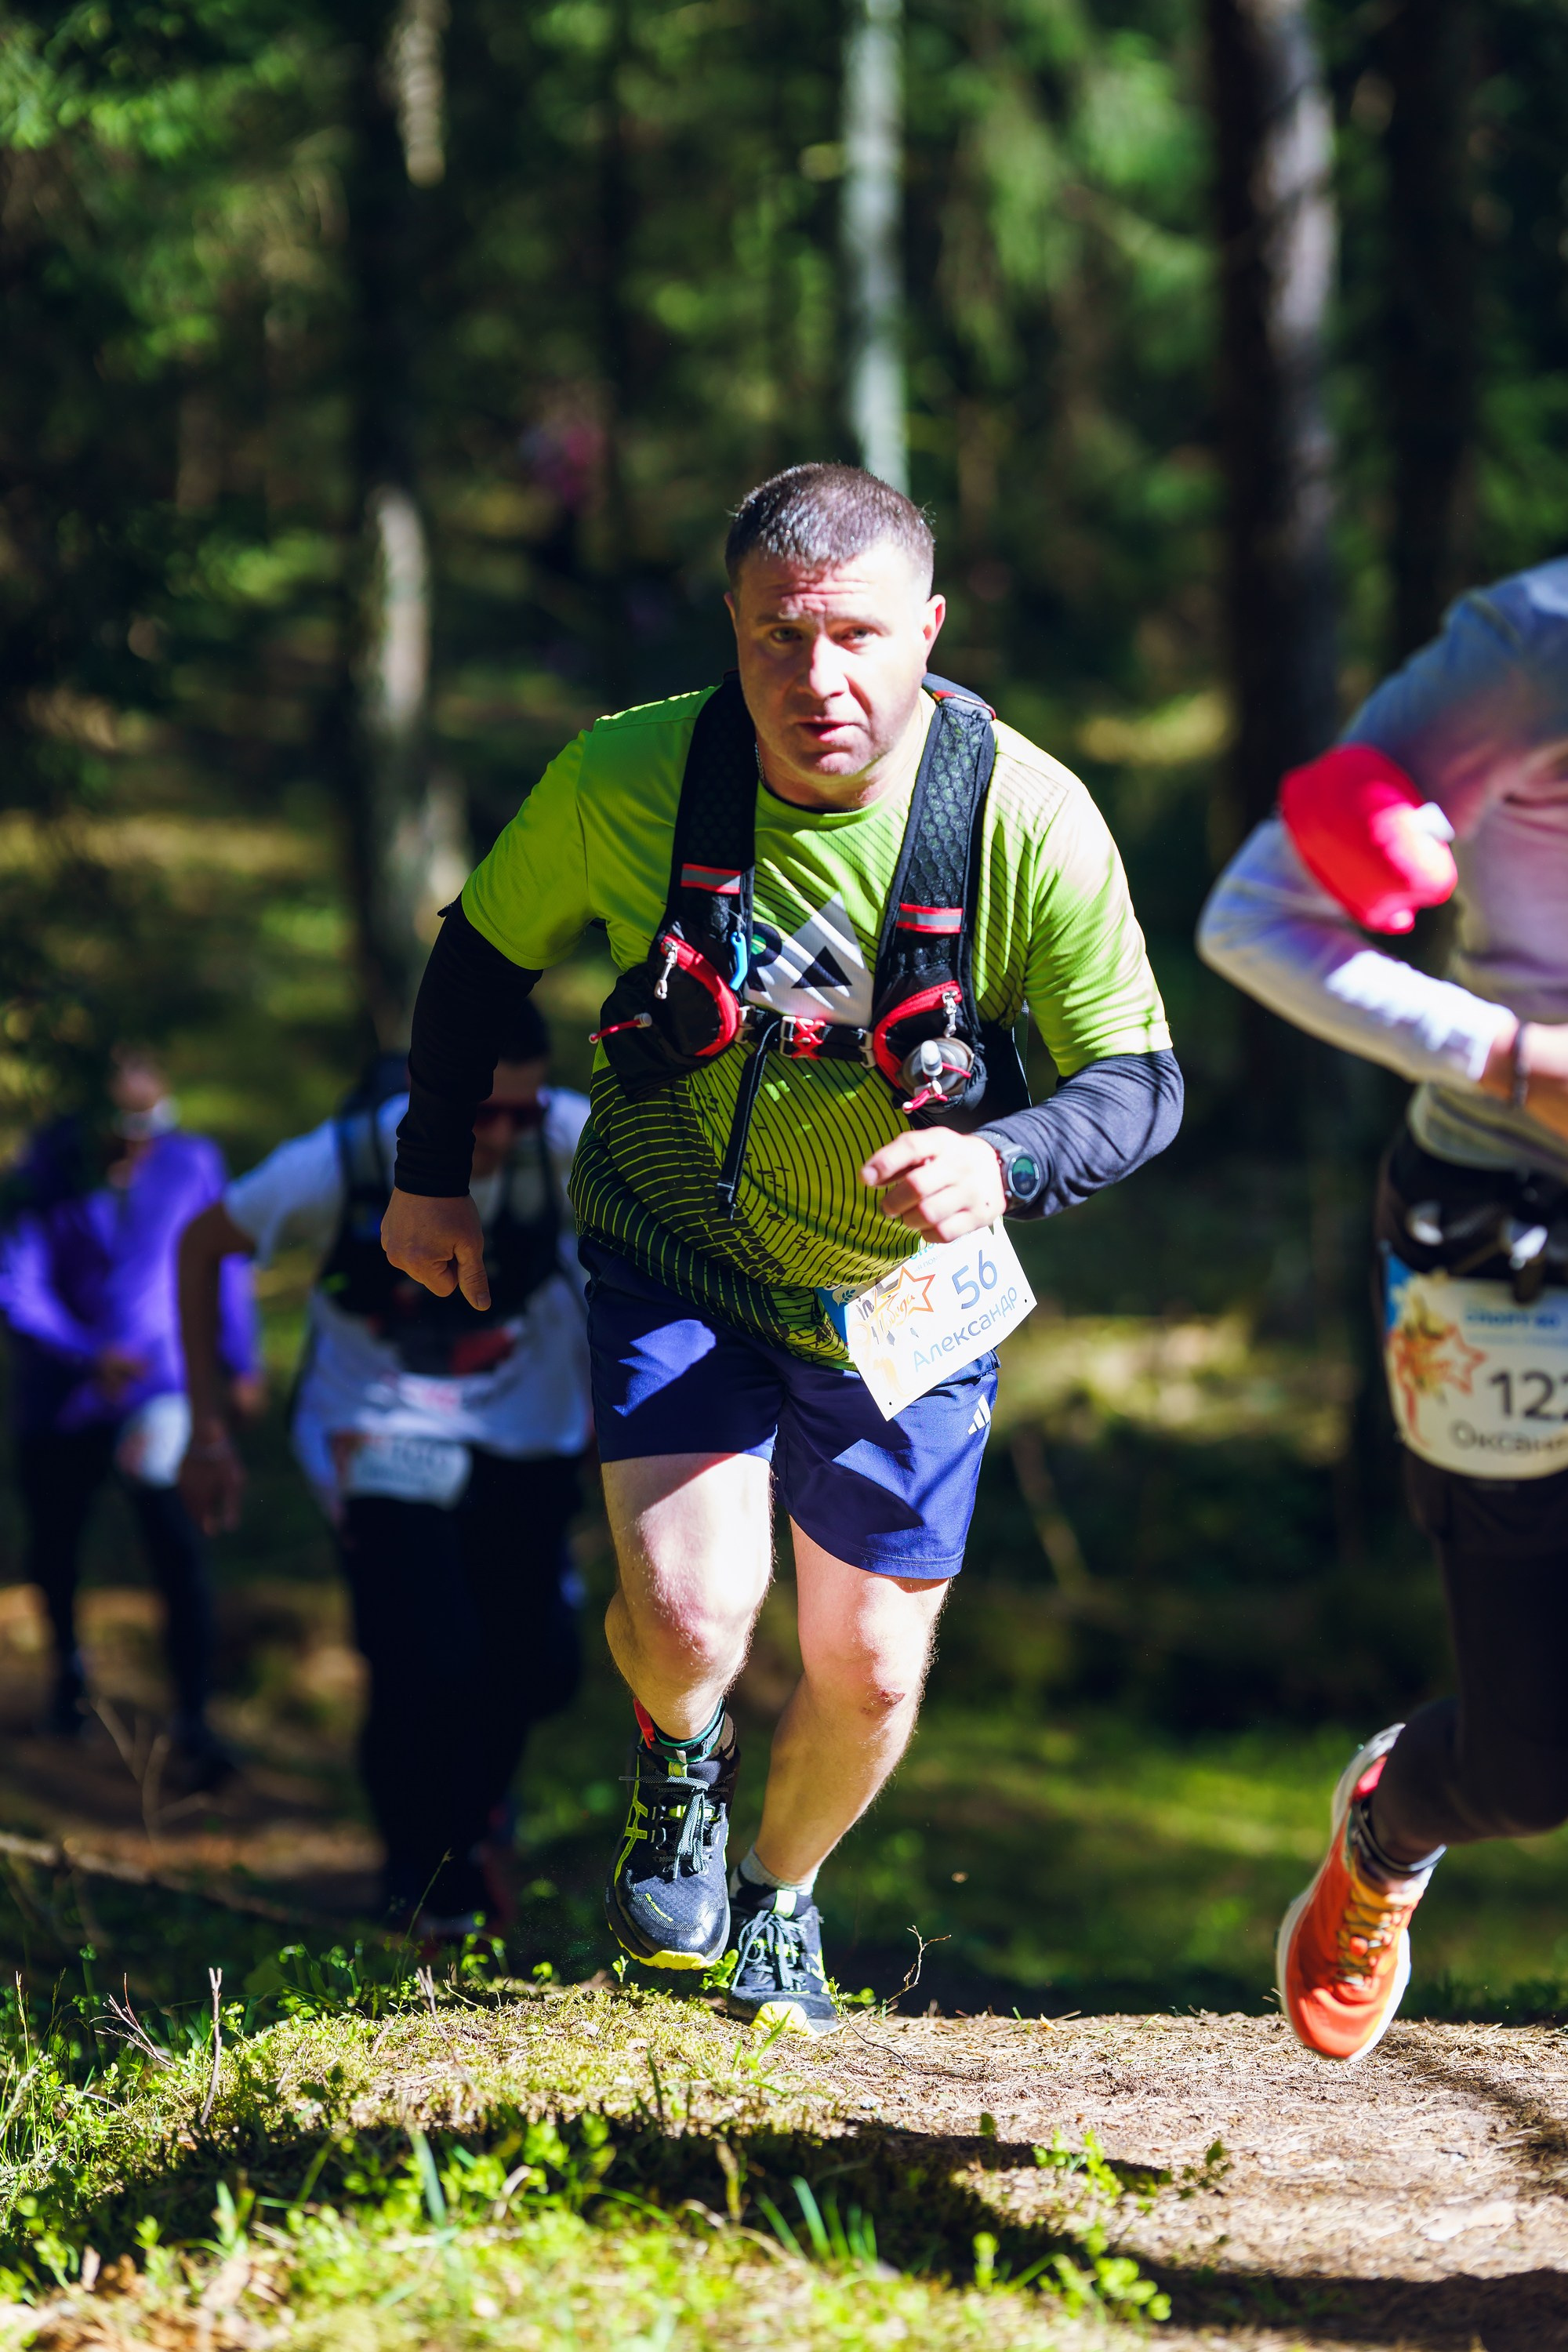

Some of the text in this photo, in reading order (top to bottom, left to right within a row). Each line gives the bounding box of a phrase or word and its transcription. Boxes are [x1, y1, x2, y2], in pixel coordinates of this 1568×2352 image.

[951, 1250, 998, 1310] 56
[913, 1287, 1018, 1373] Александр
[1490, 1369, 1568, 1423] 12
